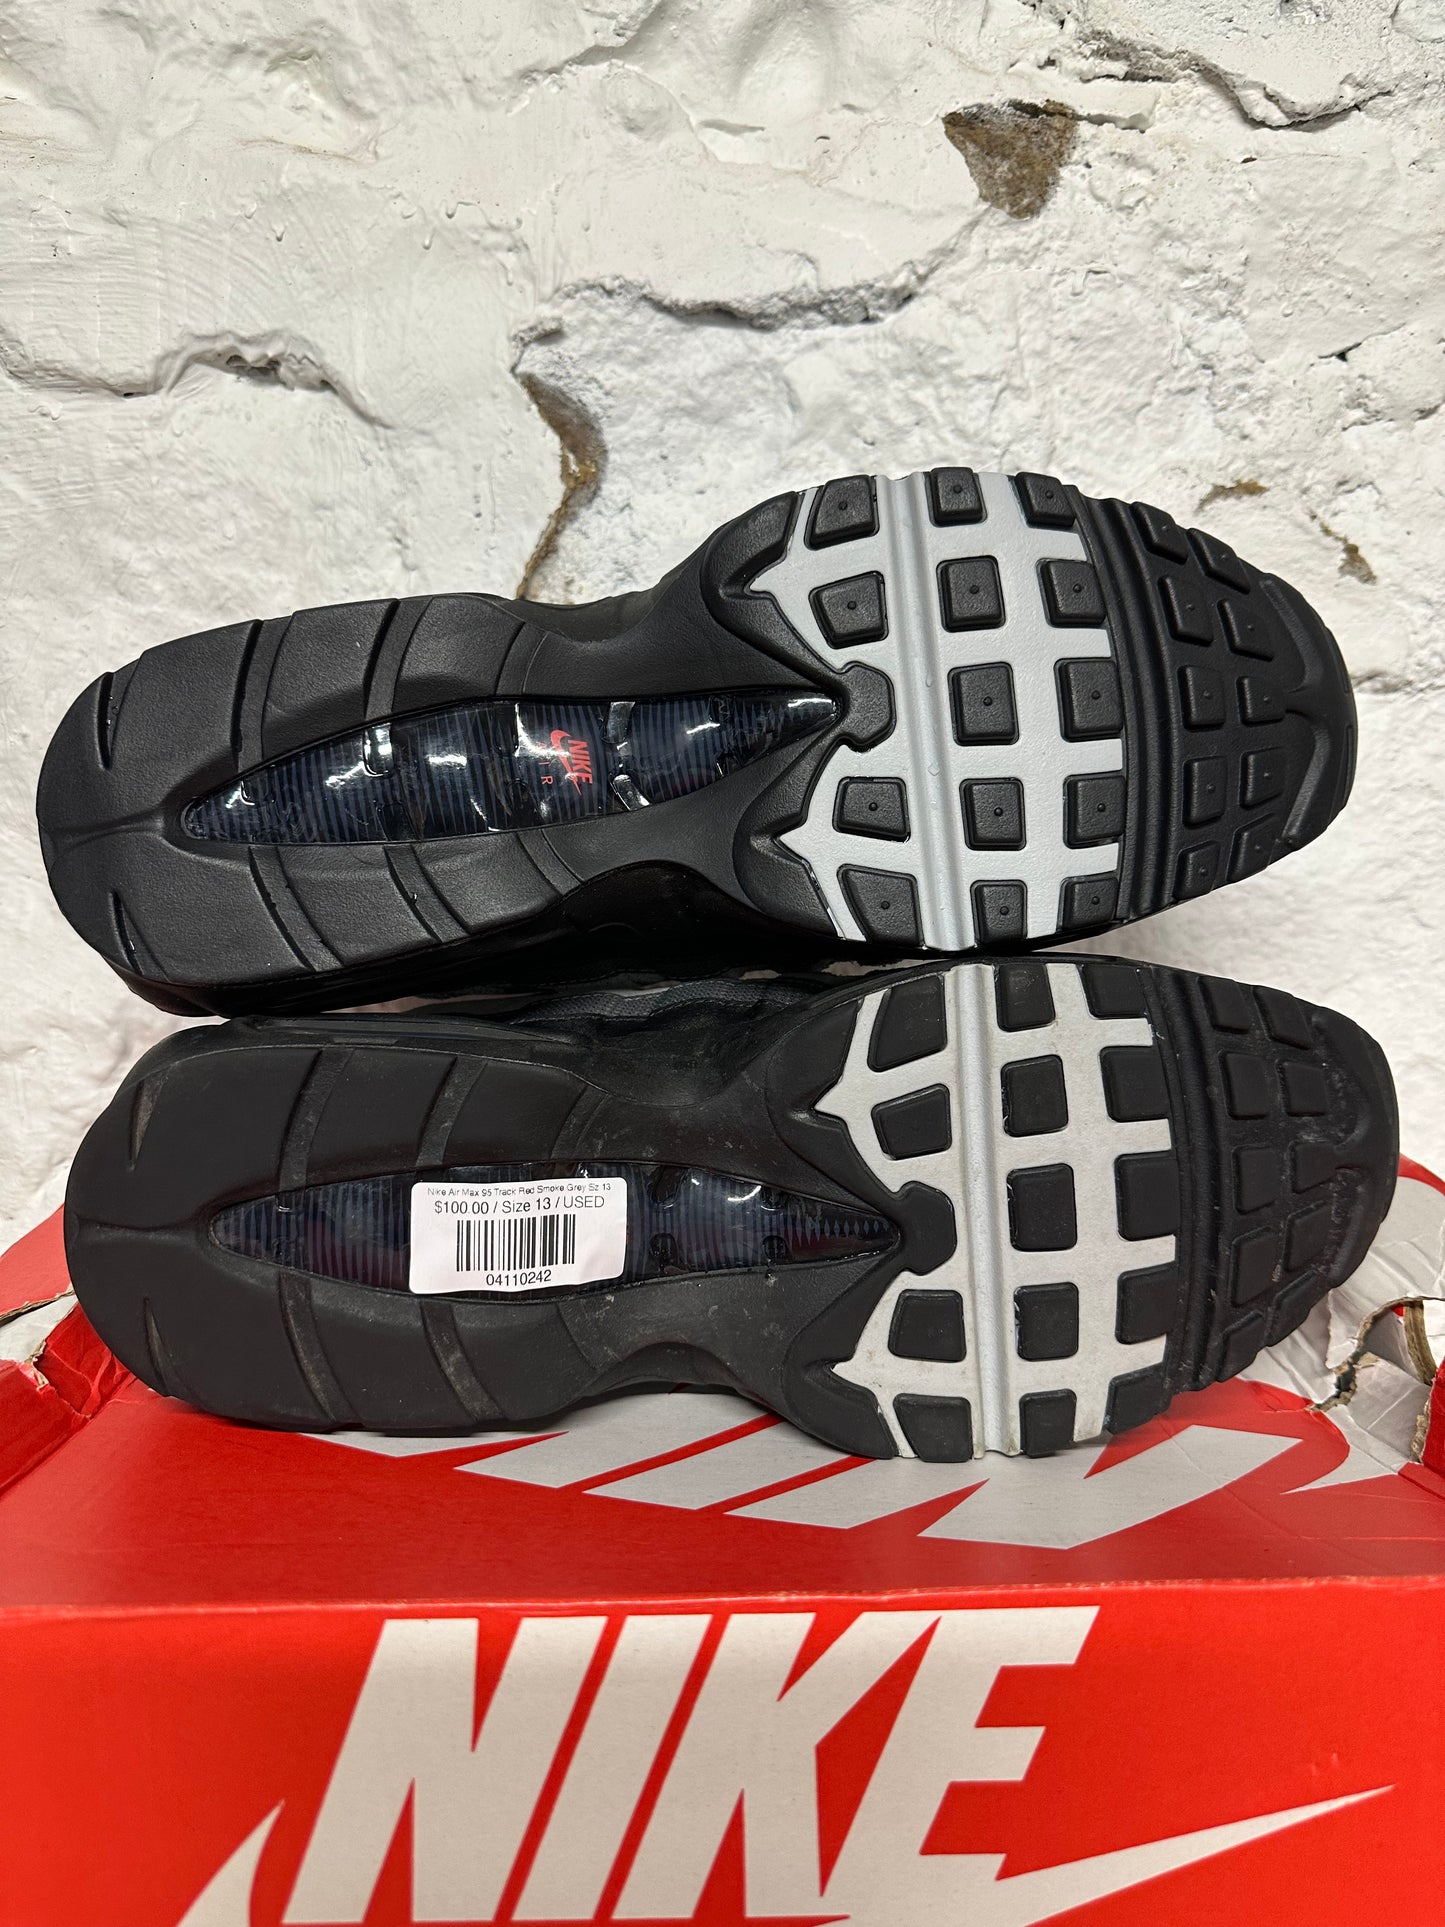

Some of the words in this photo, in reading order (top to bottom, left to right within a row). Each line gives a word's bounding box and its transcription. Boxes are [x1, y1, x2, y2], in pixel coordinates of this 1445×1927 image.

[568, 740, 593, 784] NIKE
[428, 1188, 446, 1196] Nike
[448, 1188, 459, 1196] Air
[462, 1188, 479, 1197] Max
[482, 1187, 492, 1196] 95
[495, 1187, 517, 1196] Track
[519, 1186, 535, 1195] Red
[537, 1184, 564, 1193] Smoke
[567, 1183, 586, 1193] Grey
[588, 1184, 599, 1192] Sz
[602, 1183, 611, 1191] 13
[434, 1201, 489, 1214] $100.00
[493, 1201, 498, 1213] /
[502, 1200, 531, 1213] Size
[536, 1197, 551, 1210] 13
[555, 1197, 559, 1209] /
[563, 1196, 604, 1209] USED
[486, 1270, 552, 1286] 04110242
[283, 1606, 1099, 1923] NIKE
